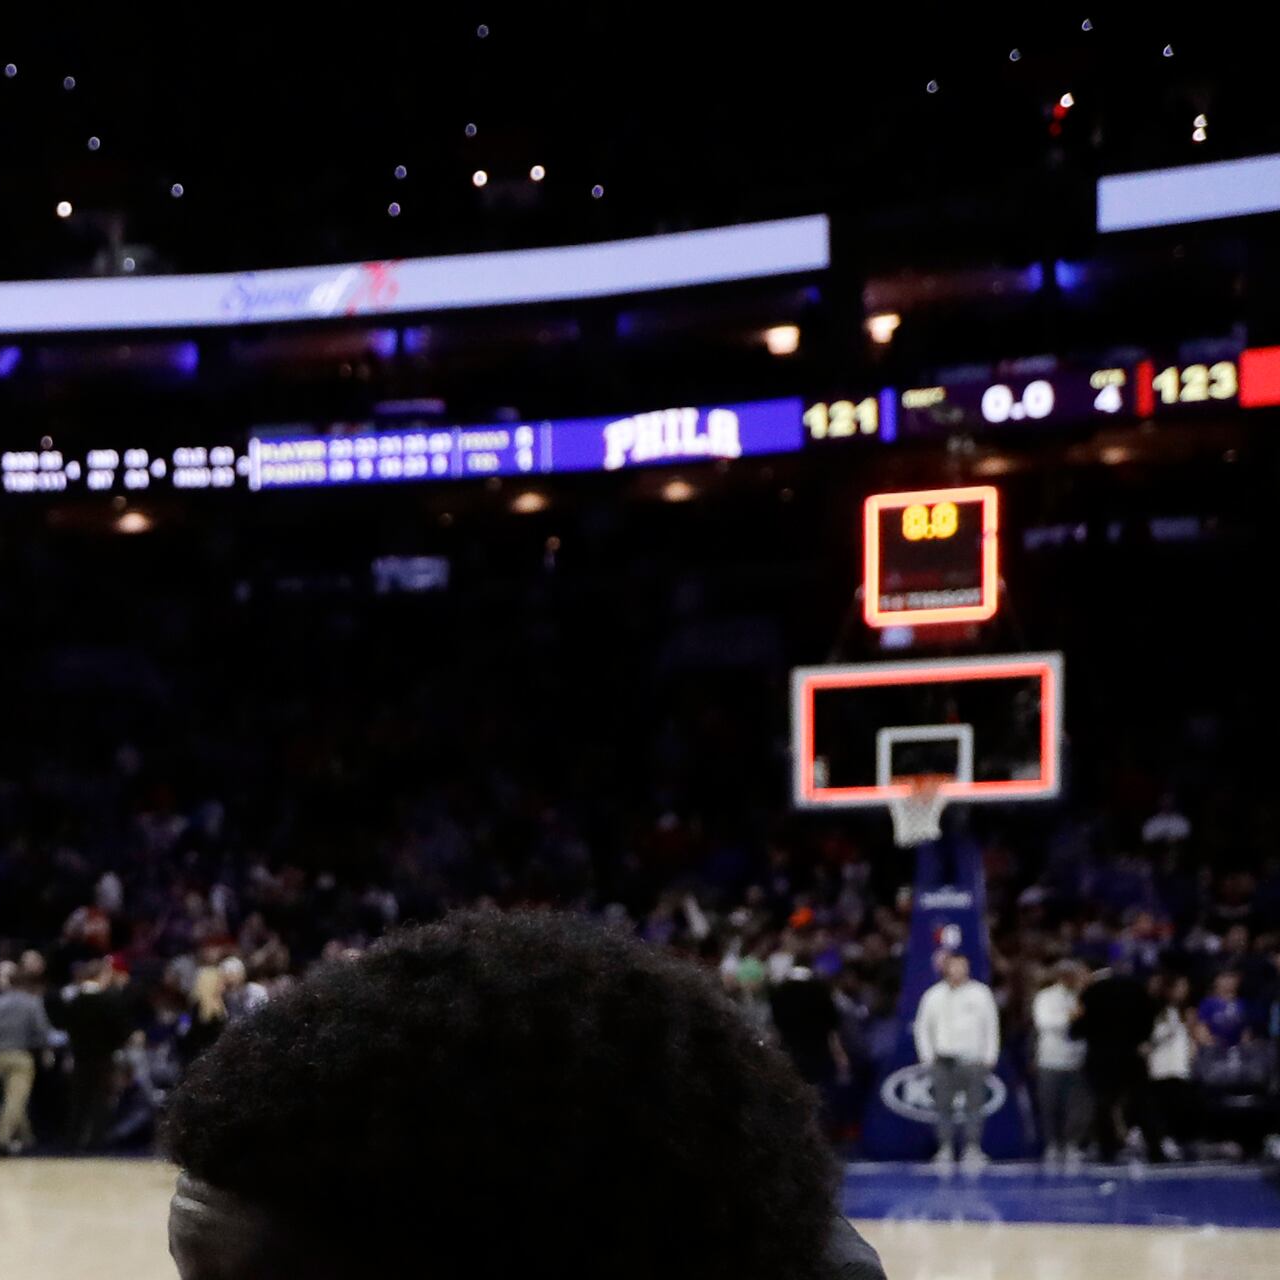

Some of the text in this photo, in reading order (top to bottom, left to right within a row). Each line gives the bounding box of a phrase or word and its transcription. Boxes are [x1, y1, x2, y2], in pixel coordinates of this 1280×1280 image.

[981, 380, 1055, 423] 0.0
[1152, 360, 1238, 404] 123
[603, 406, 742, 471] PHILA
[803, 397, 878, 440] 121
